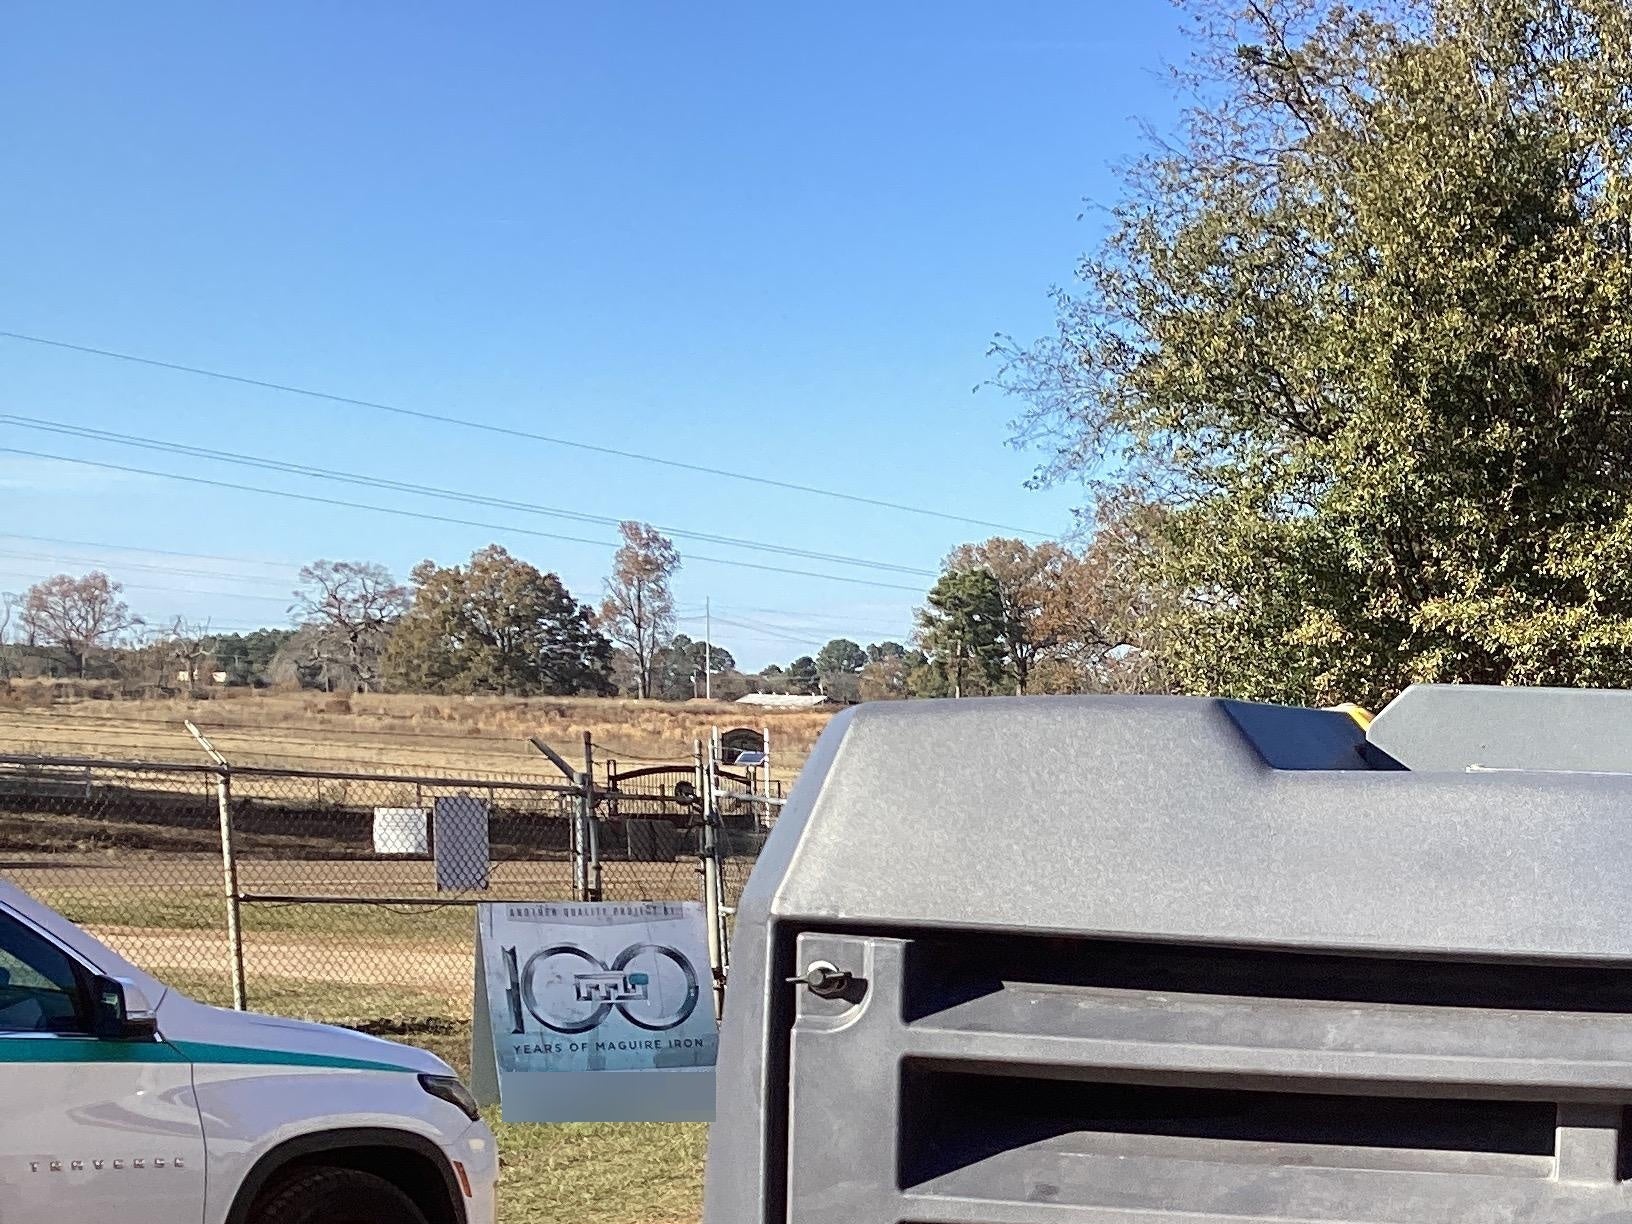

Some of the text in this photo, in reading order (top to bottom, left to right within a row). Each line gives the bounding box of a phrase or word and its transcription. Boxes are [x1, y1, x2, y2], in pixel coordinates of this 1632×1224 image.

[513, 1037, 705, 1055] YEARS OF MAGUIRE IRON
